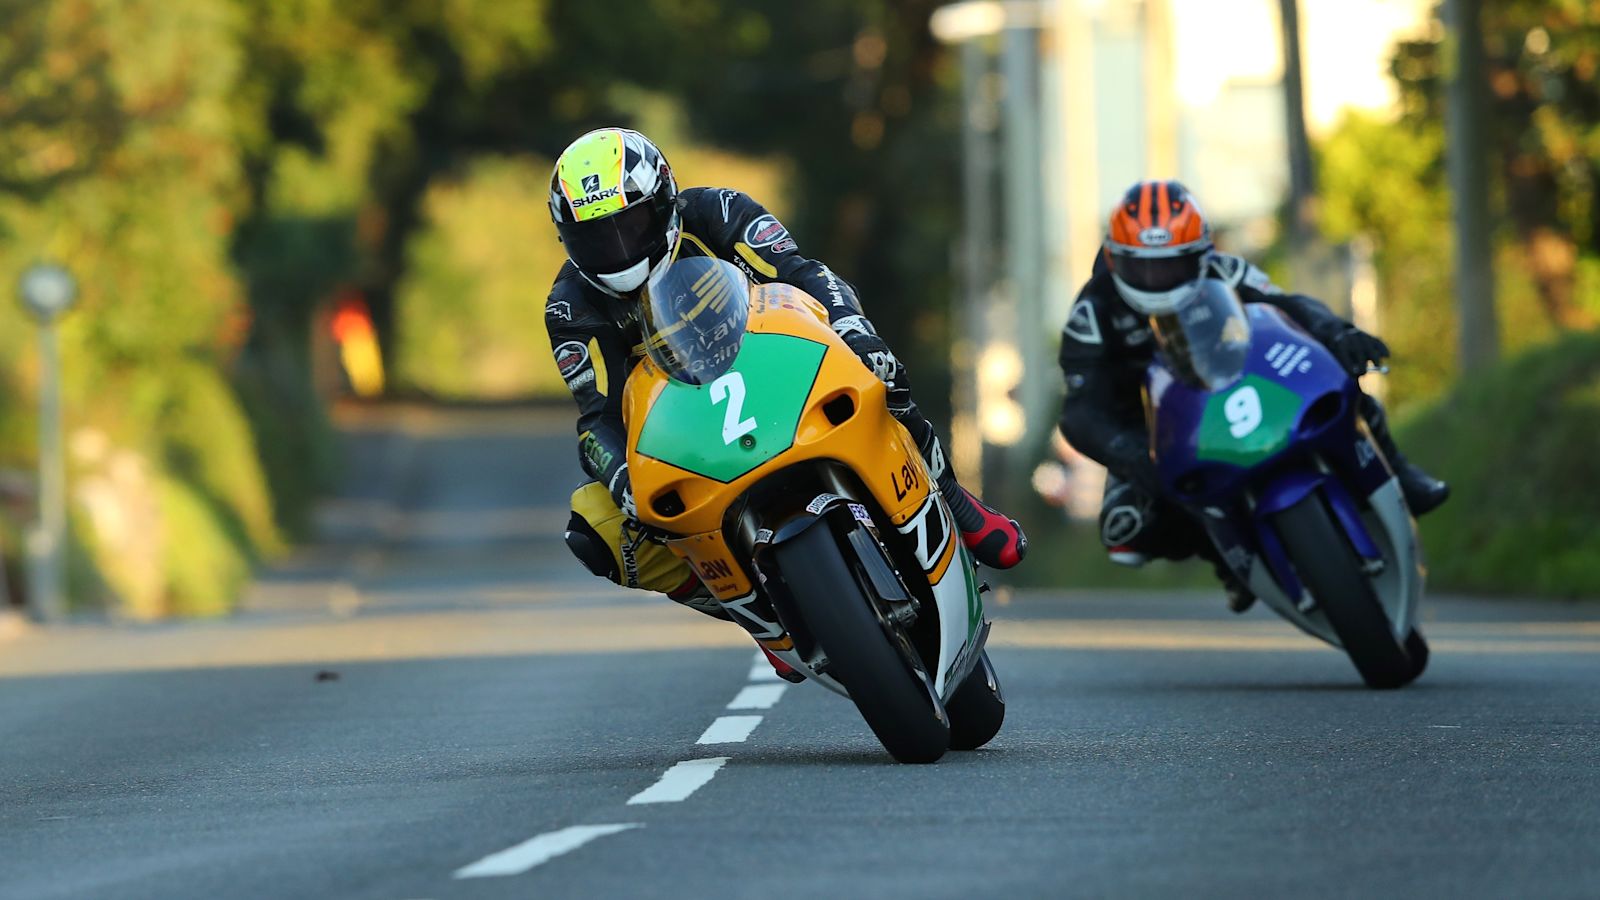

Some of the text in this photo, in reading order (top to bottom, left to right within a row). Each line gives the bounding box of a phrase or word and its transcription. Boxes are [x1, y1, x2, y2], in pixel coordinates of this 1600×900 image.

[572, 185, 620, 208] SHARK
[709, 371, 757, 444] 2
[1224, 385, 1263, 439] 9
